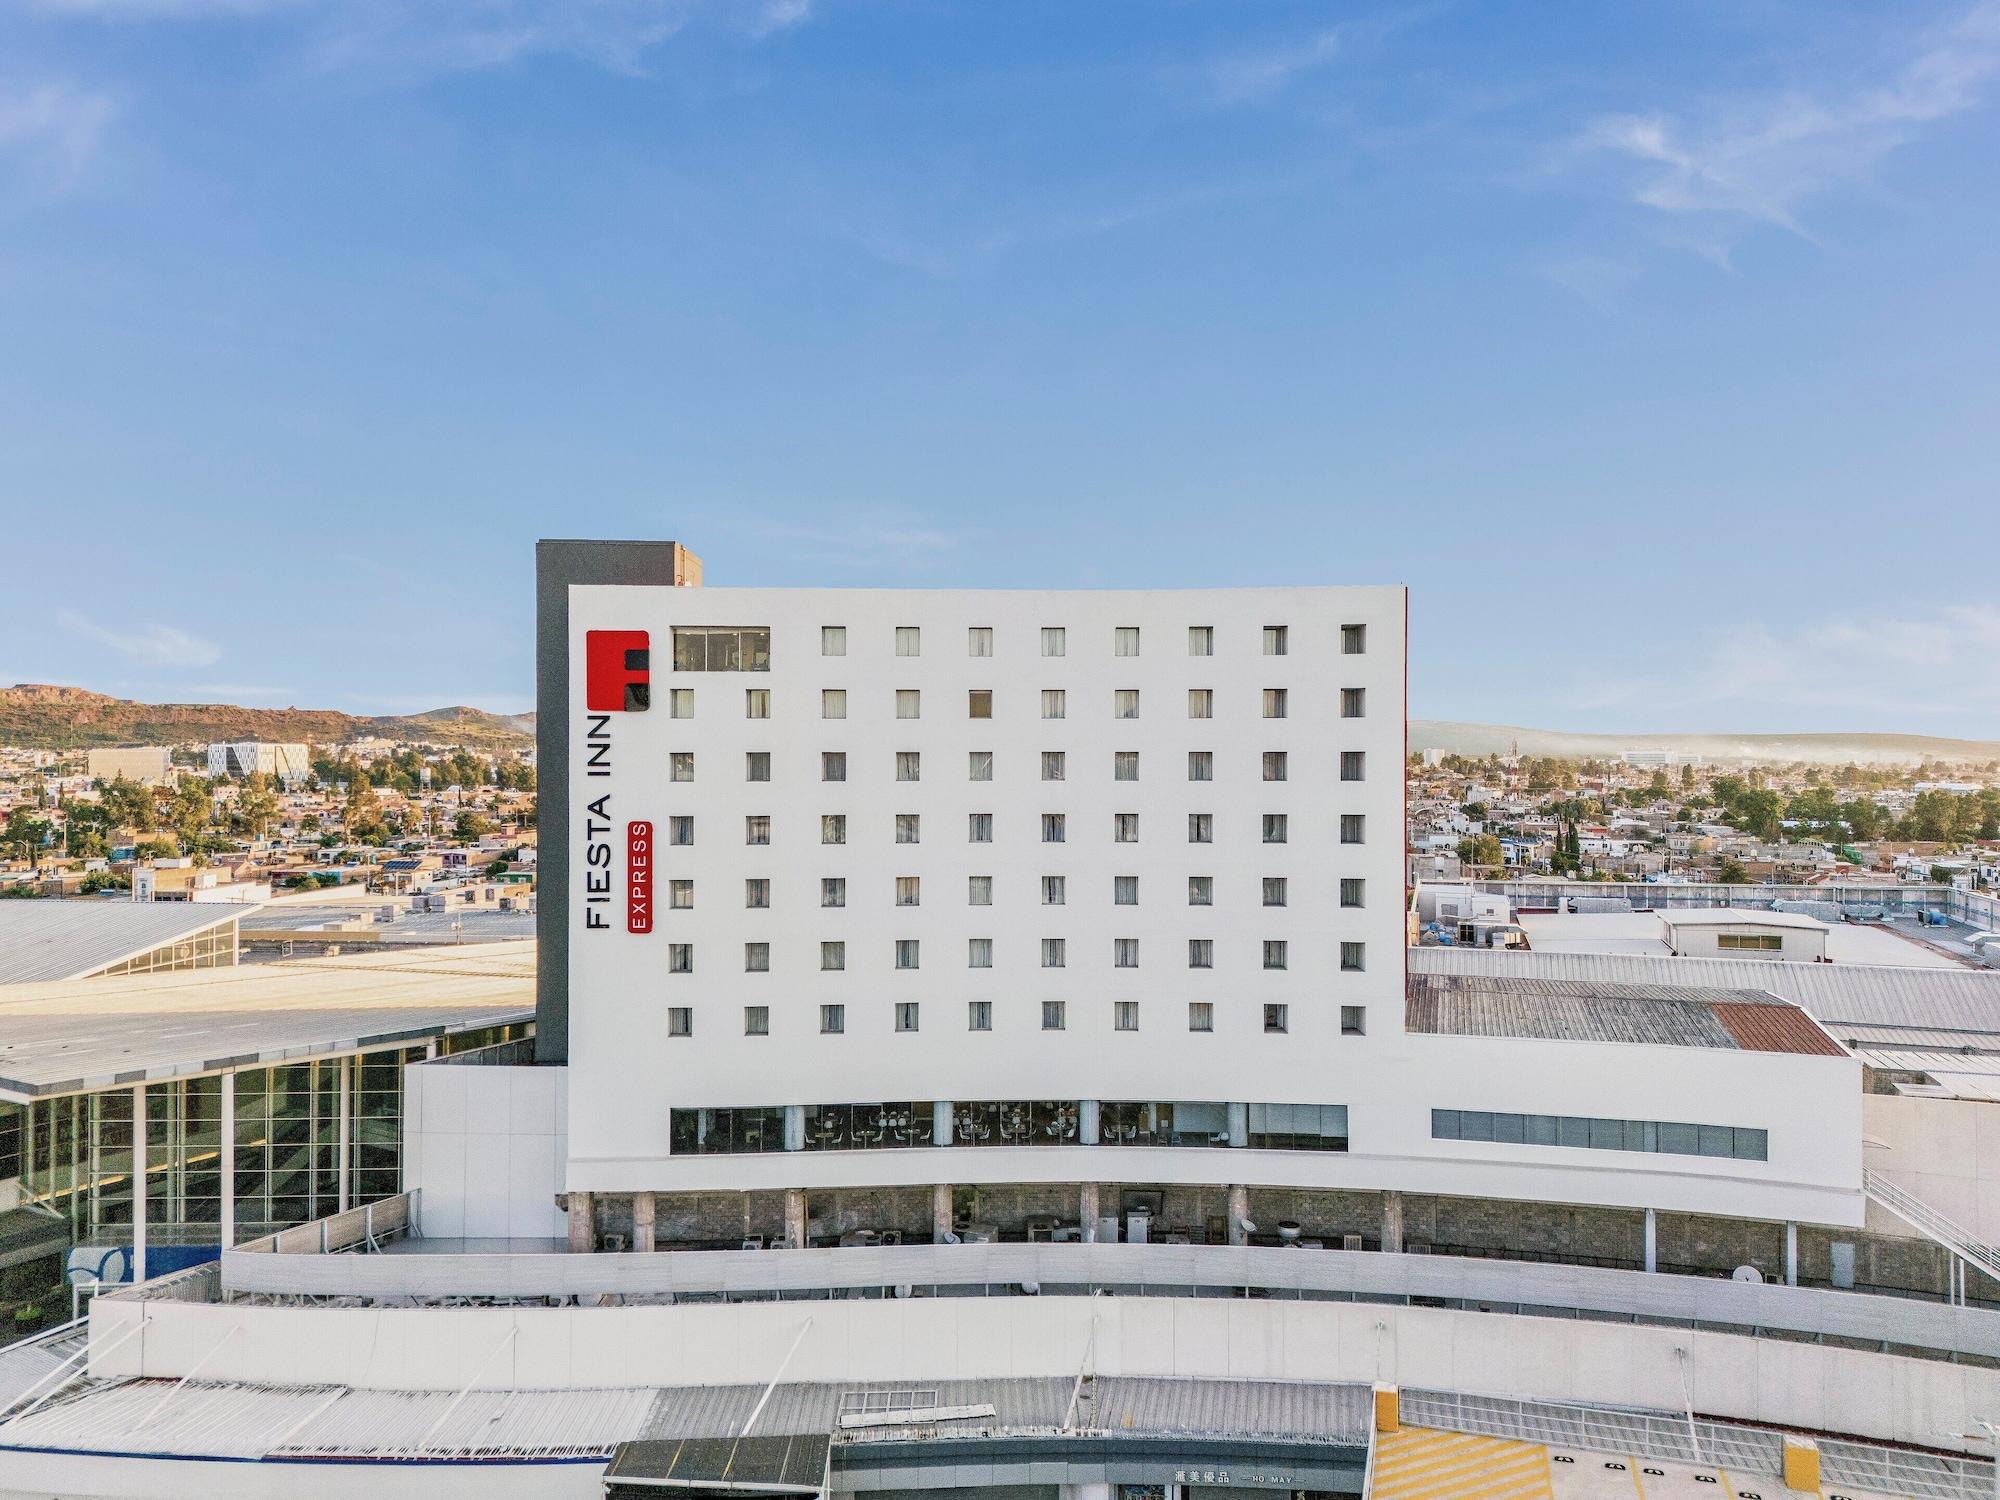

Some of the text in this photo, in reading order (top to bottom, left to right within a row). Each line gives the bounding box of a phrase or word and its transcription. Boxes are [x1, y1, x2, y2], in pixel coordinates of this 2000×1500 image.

[587, 715, 611, 928] FIESTA INN
[633, 824, 647, 929] EXPRESS
[1271, 1476, 1292, 1484] MAY
